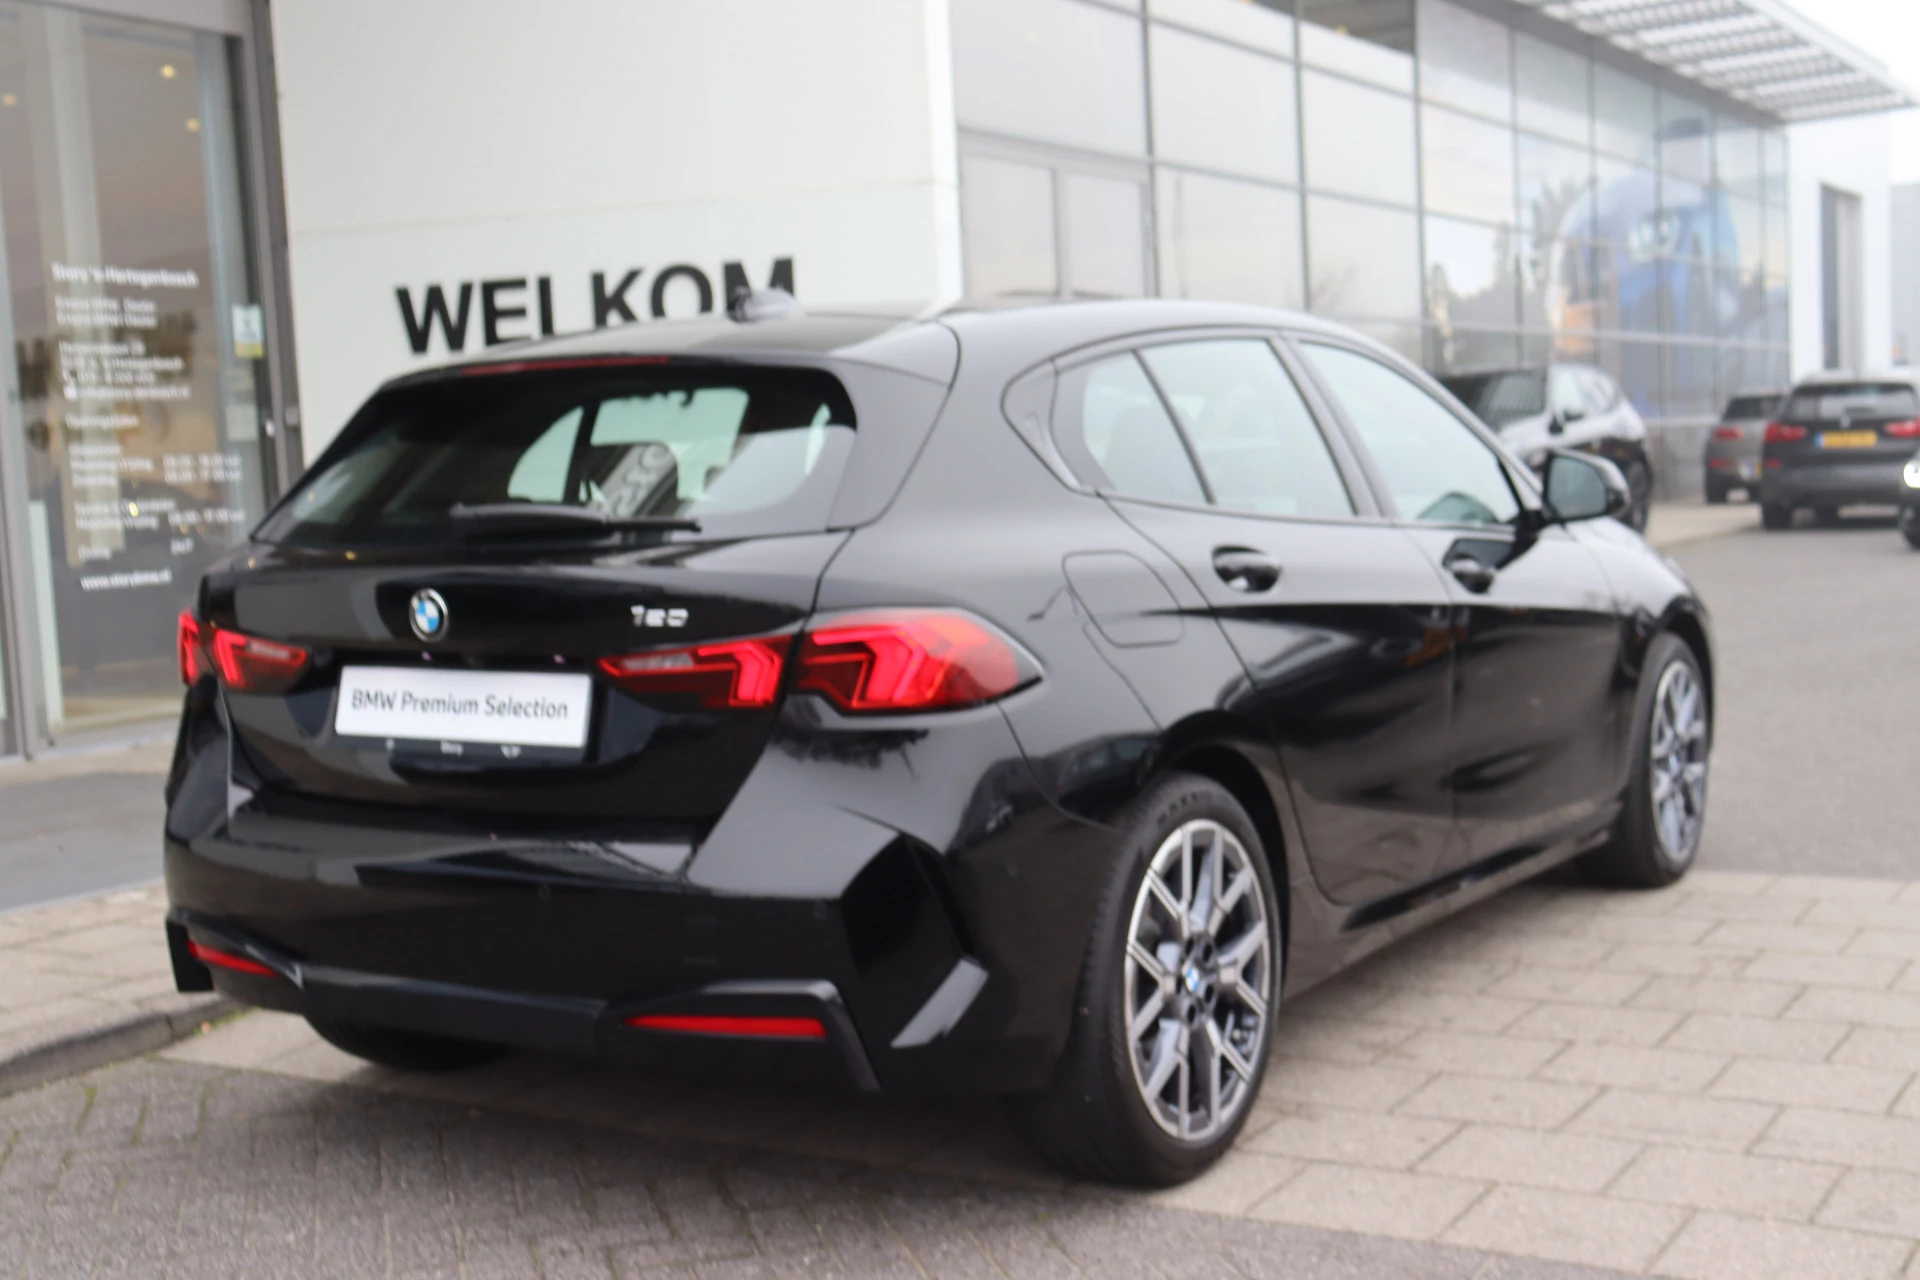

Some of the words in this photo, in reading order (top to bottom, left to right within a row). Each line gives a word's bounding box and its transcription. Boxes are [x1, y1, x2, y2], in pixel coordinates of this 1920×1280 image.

[351, 689, 397, 712] BMW
[400, 691, 479, 715] Premium
[484, 694, 569, 719] Selection
